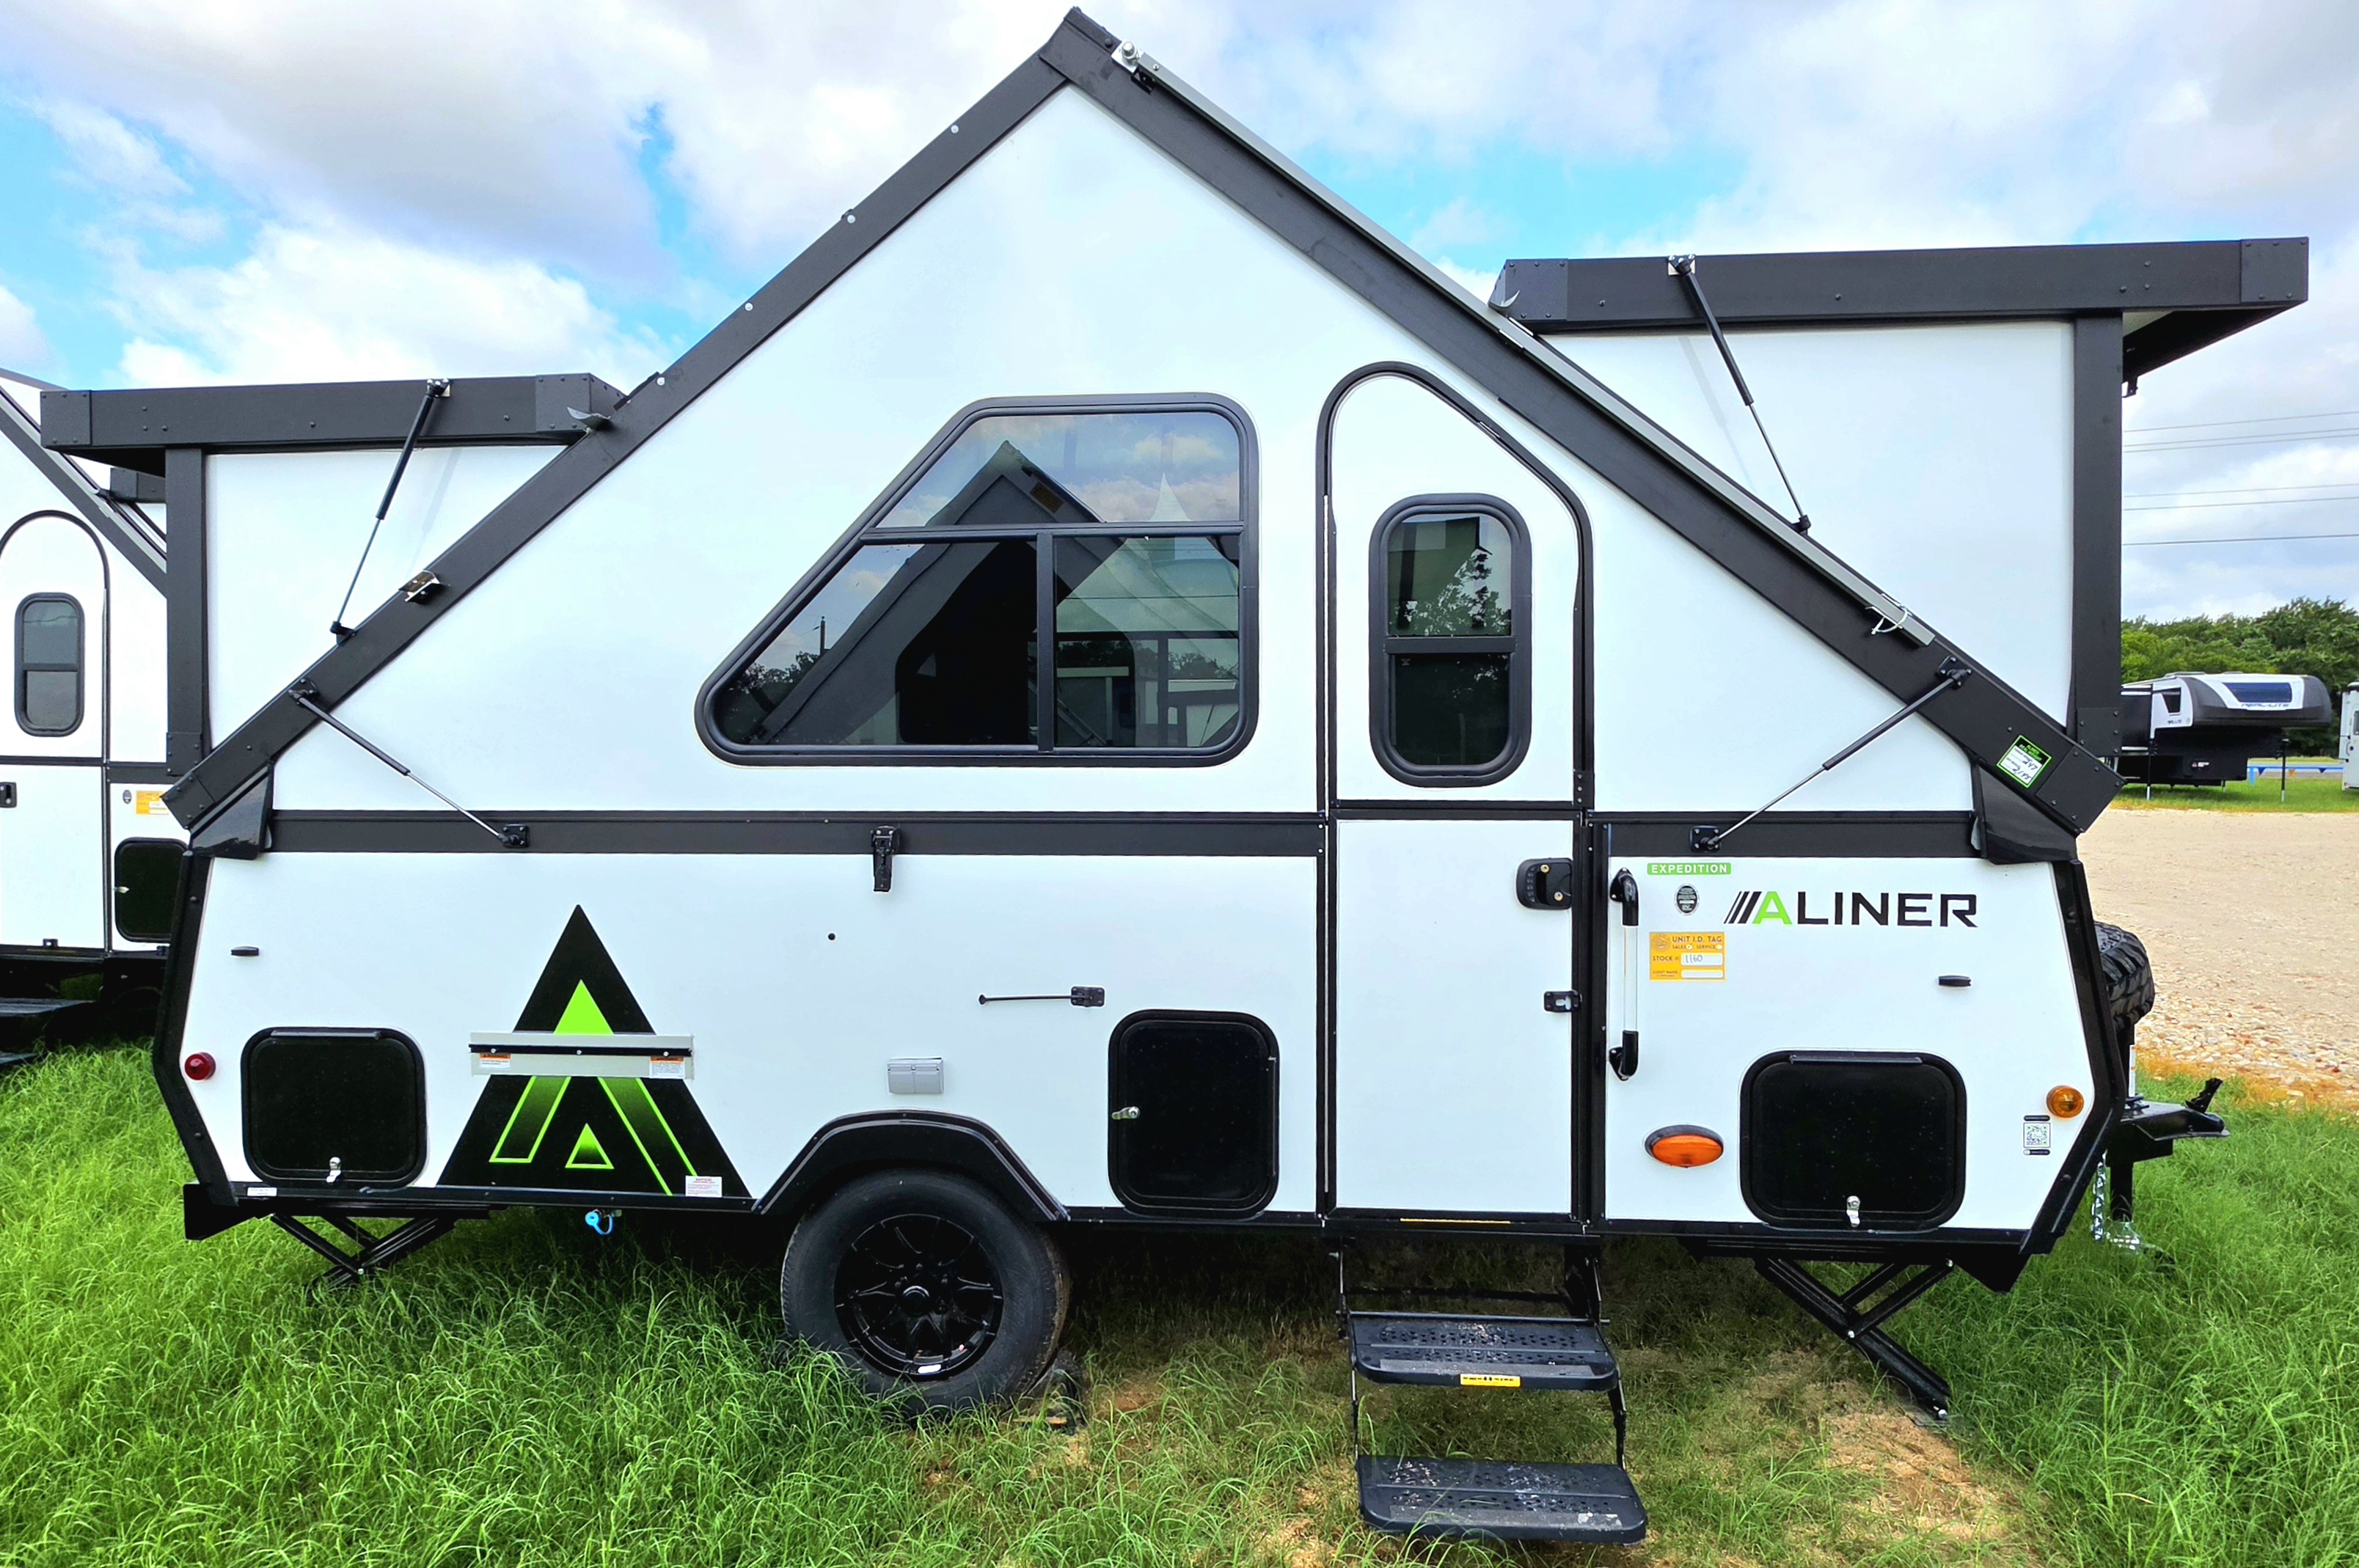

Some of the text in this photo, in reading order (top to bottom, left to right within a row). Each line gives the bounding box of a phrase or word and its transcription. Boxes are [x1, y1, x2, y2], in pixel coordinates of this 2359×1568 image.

[1651, 864, 1727, 873] EXPEDITION
[1752, 890, 1978, 928] ALINER
[1686, 955, 1703, 963] 1160
